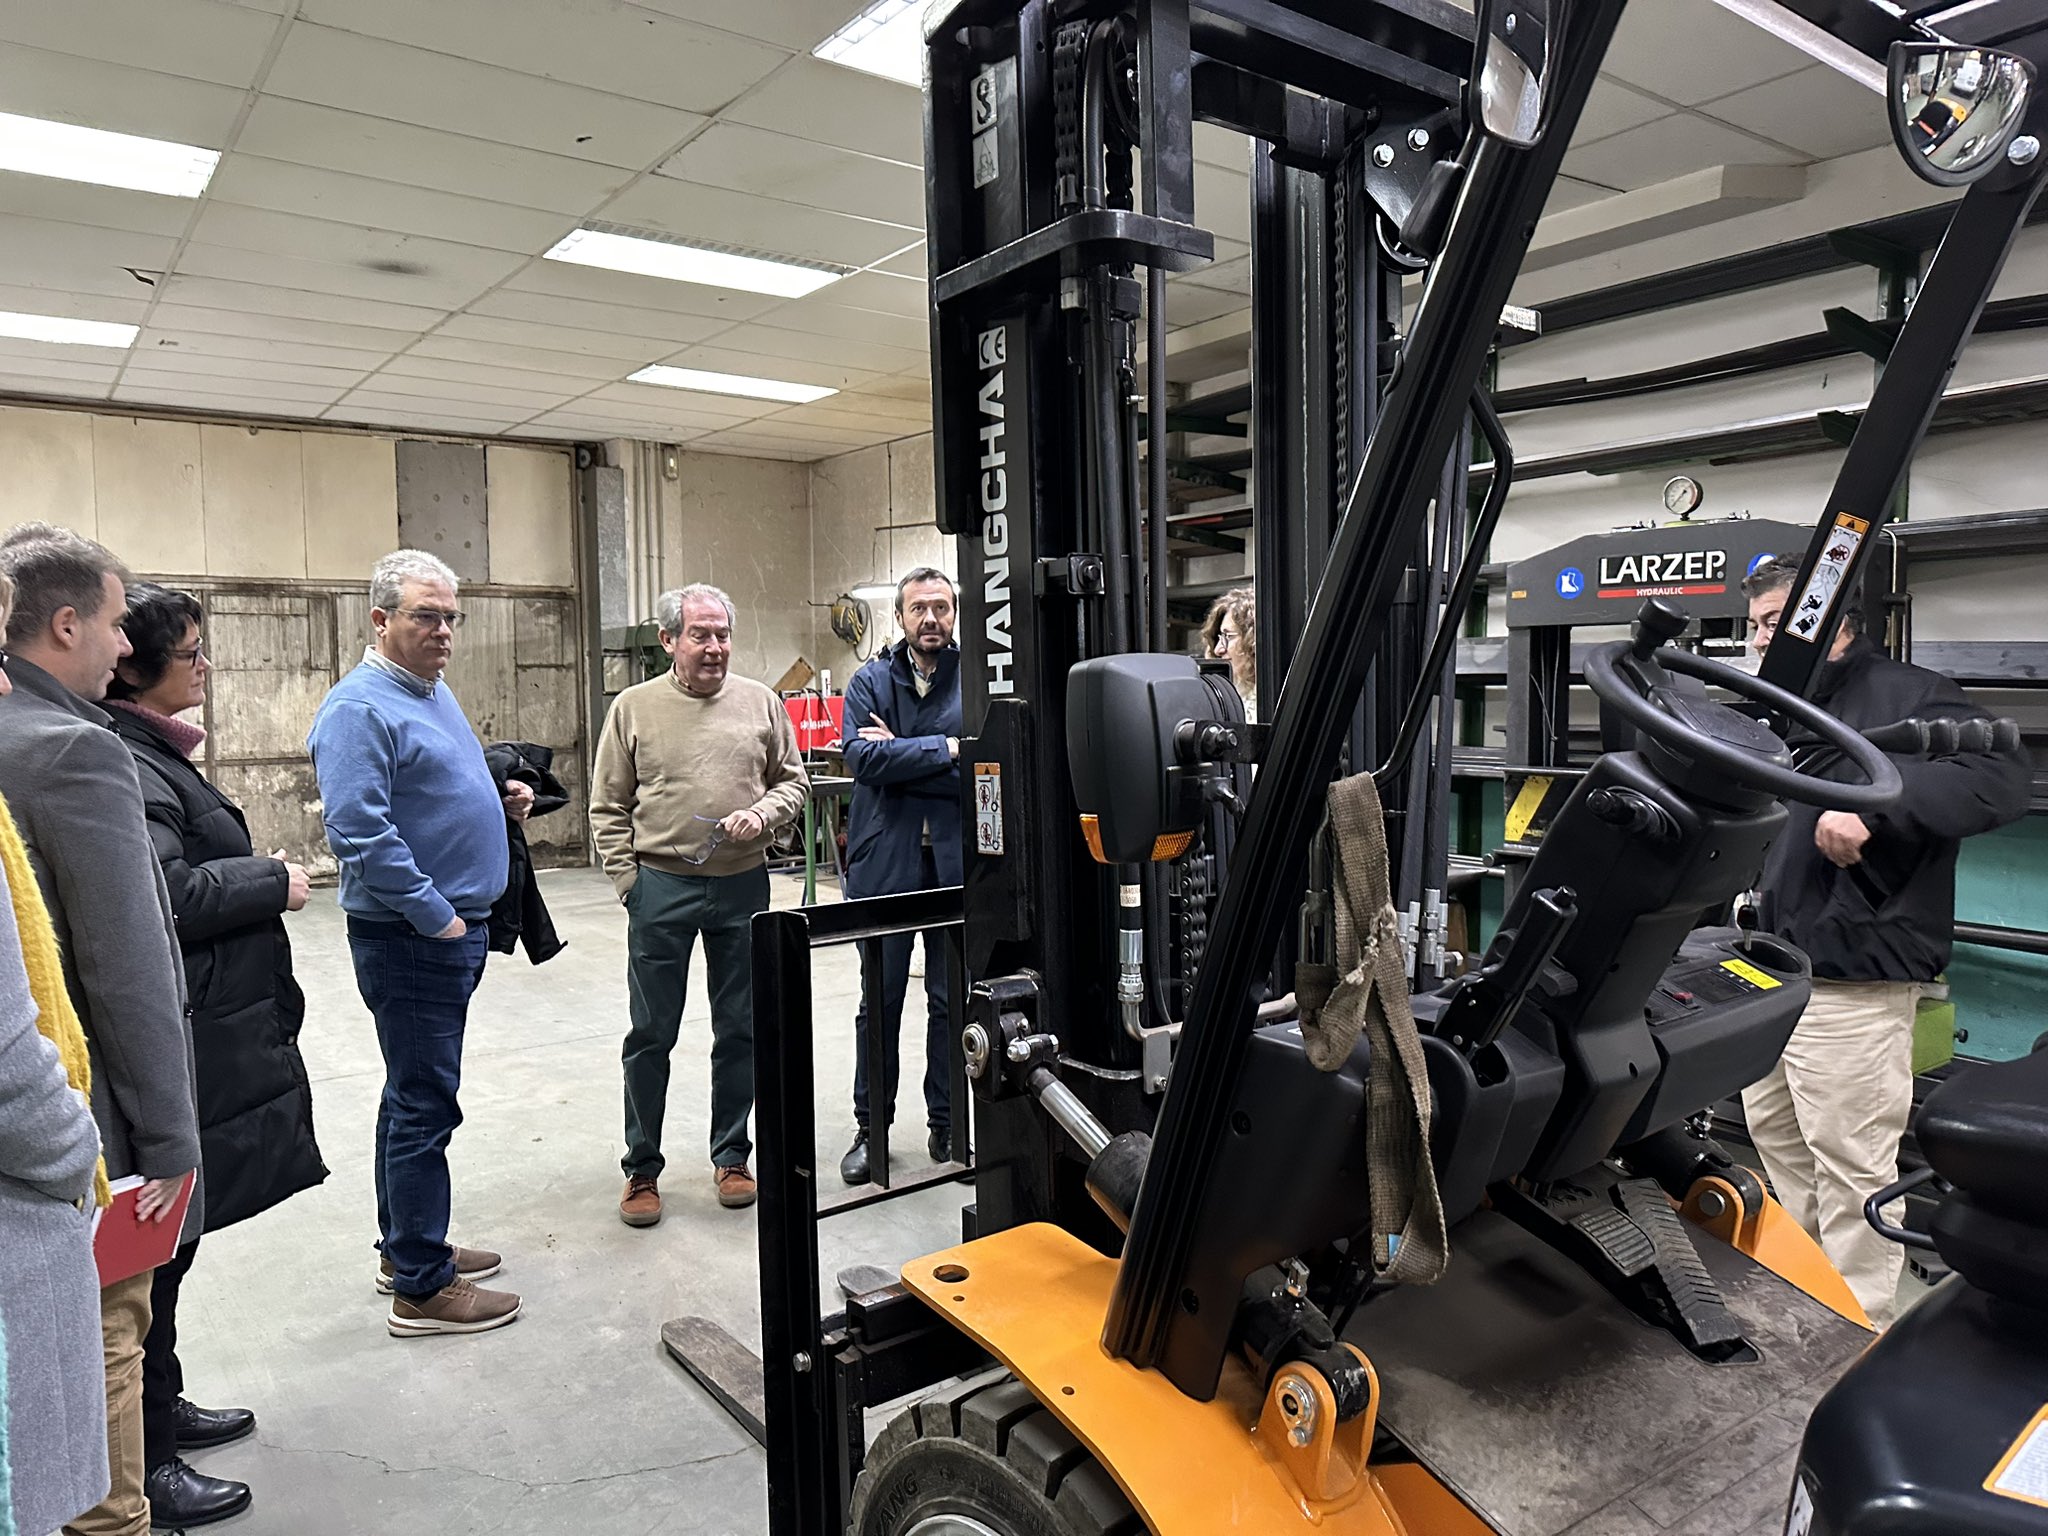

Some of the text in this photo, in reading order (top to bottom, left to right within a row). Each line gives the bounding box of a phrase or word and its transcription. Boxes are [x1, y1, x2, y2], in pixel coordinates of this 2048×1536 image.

[979, 328, 1005, 365] CE
[978, 370, 1014, 695] HANGCHA
[1600, 550, 1727, 584] LARZEP
[1636, 586, 1684, 597] HYDRAULIC
[874, 1470, 920, 1536] ANG
